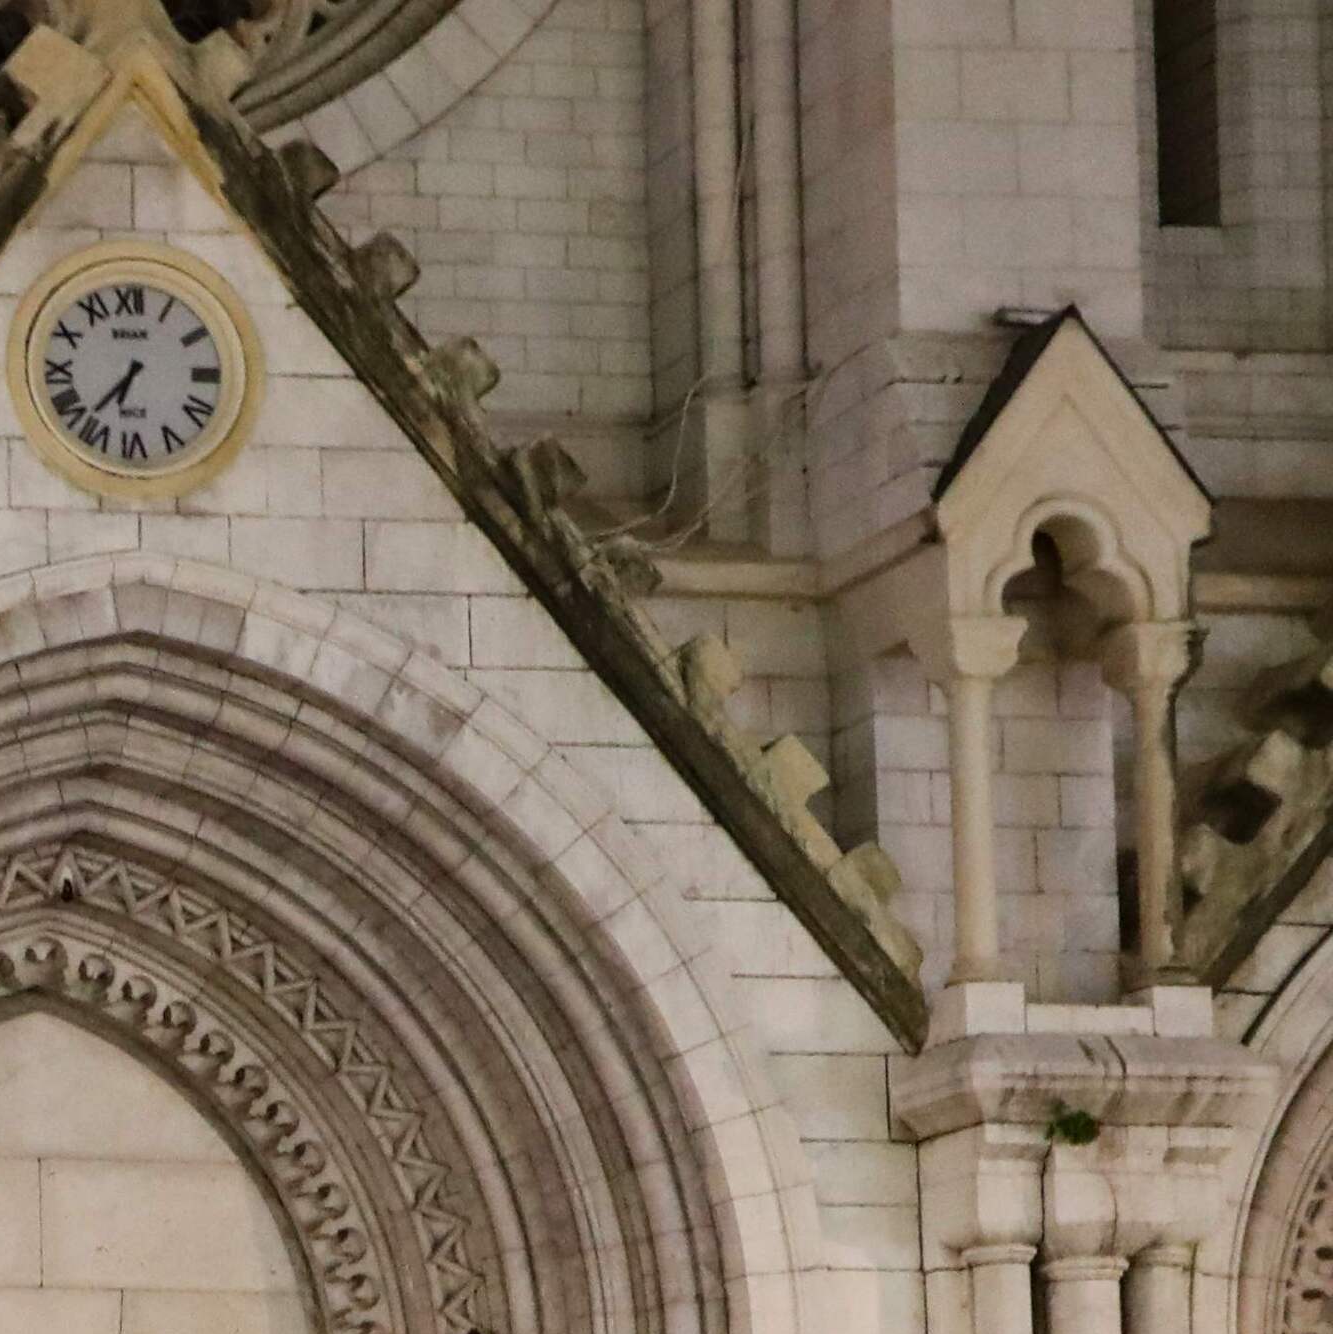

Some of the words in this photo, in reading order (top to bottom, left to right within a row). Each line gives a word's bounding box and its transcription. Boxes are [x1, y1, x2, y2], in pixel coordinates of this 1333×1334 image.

[77, 292, 110, 326] XI
[158, 297, 176, 323] I
[52, 320, 83, 349] X
[45, 359, 73, 384] IX
[182, 395, 214, 428] IV
[122, 431, 148, 459] VI
[161, 425, 186, 453] V
